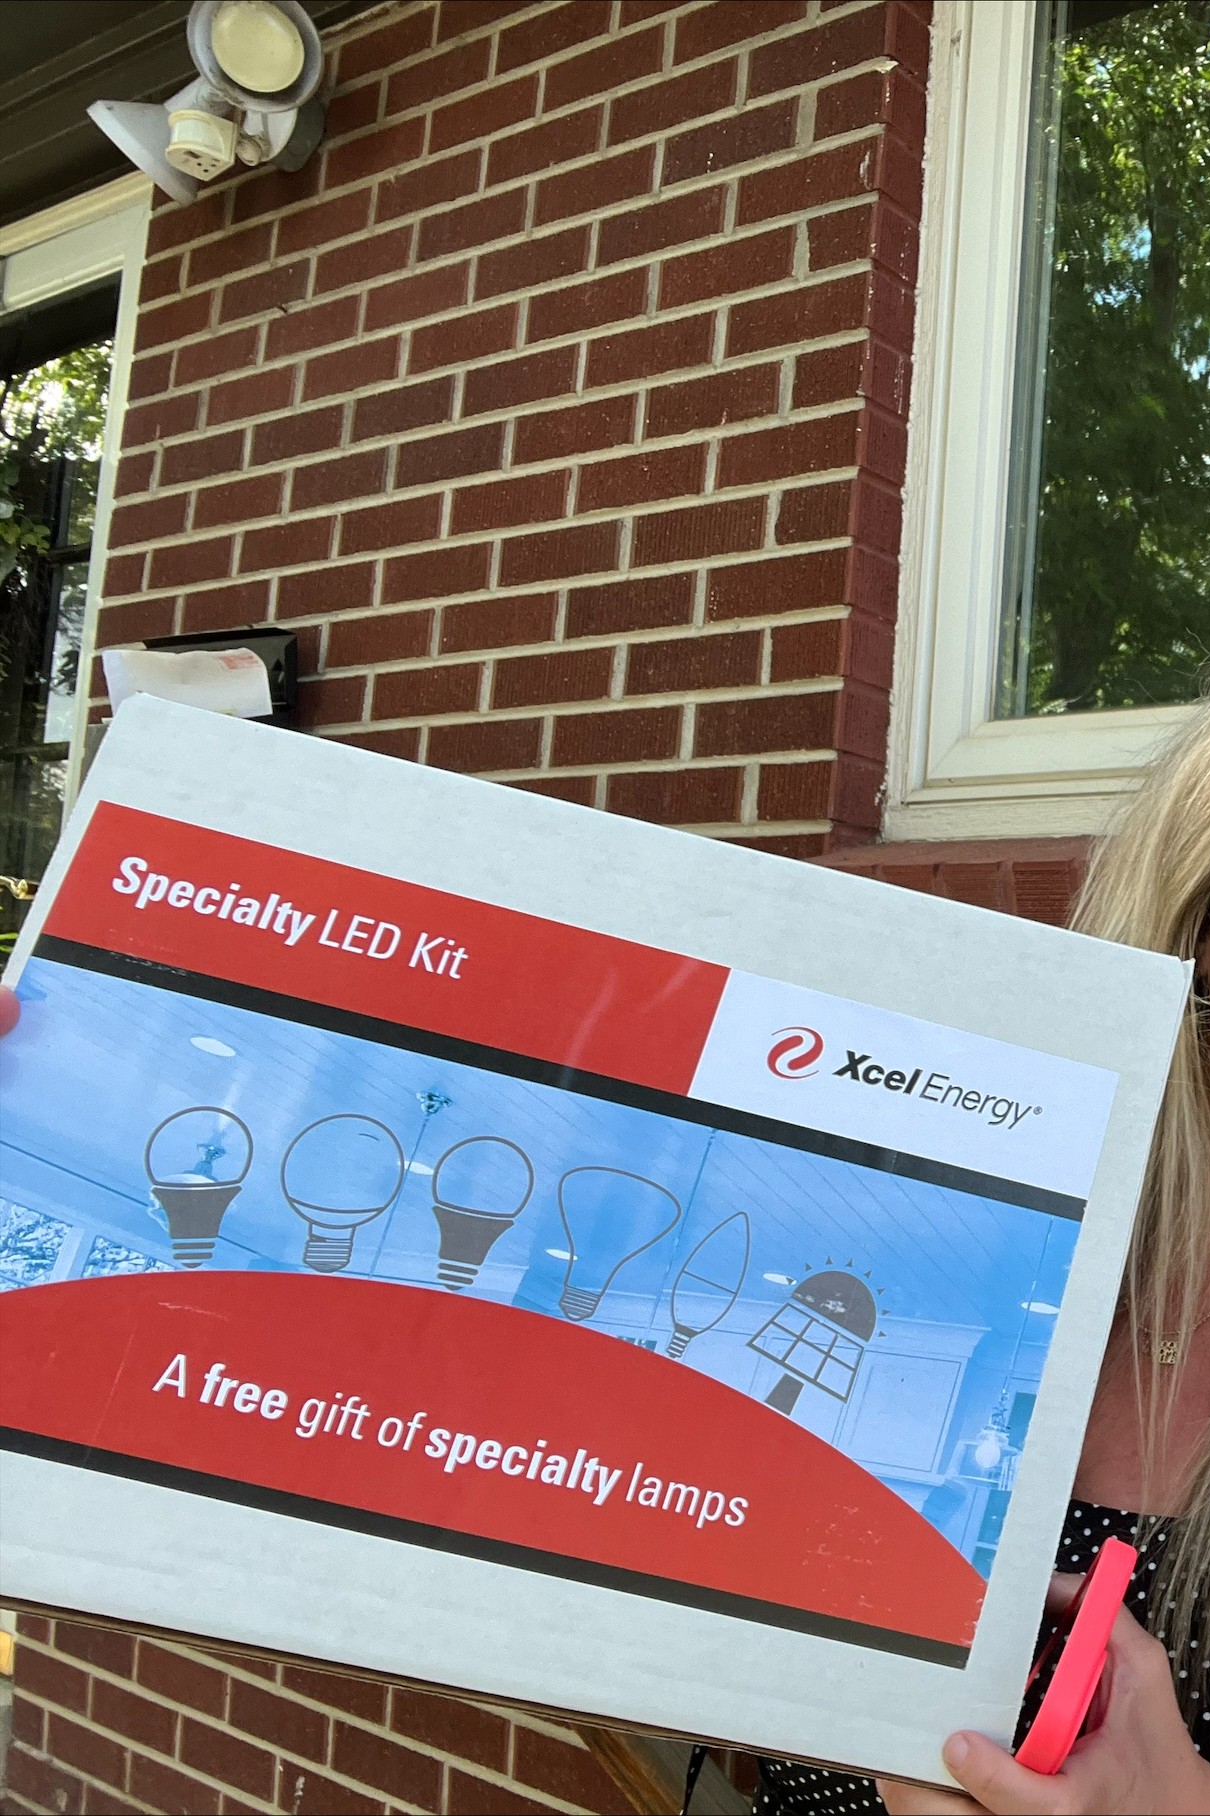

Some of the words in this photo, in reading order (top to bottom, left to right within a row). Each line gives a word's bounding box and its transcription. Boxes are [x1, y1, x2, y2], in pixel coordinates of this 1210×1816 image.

[112, 856, 317, 947] Specialty
[318, 908, 402, 961] LED
[408, 932, 470, 980] Kit
[832, 1050, 925, 1096] Xcel
[151, 1353, 187, 1399] A
[199, 1362, 289, 1420] free
[295, 1391, 372, 1441] gift
[377, 1411, 428, 1451] of
[424, 1428, 624, 1506] specialty
[625, 1461, 750, 1530] lamps
